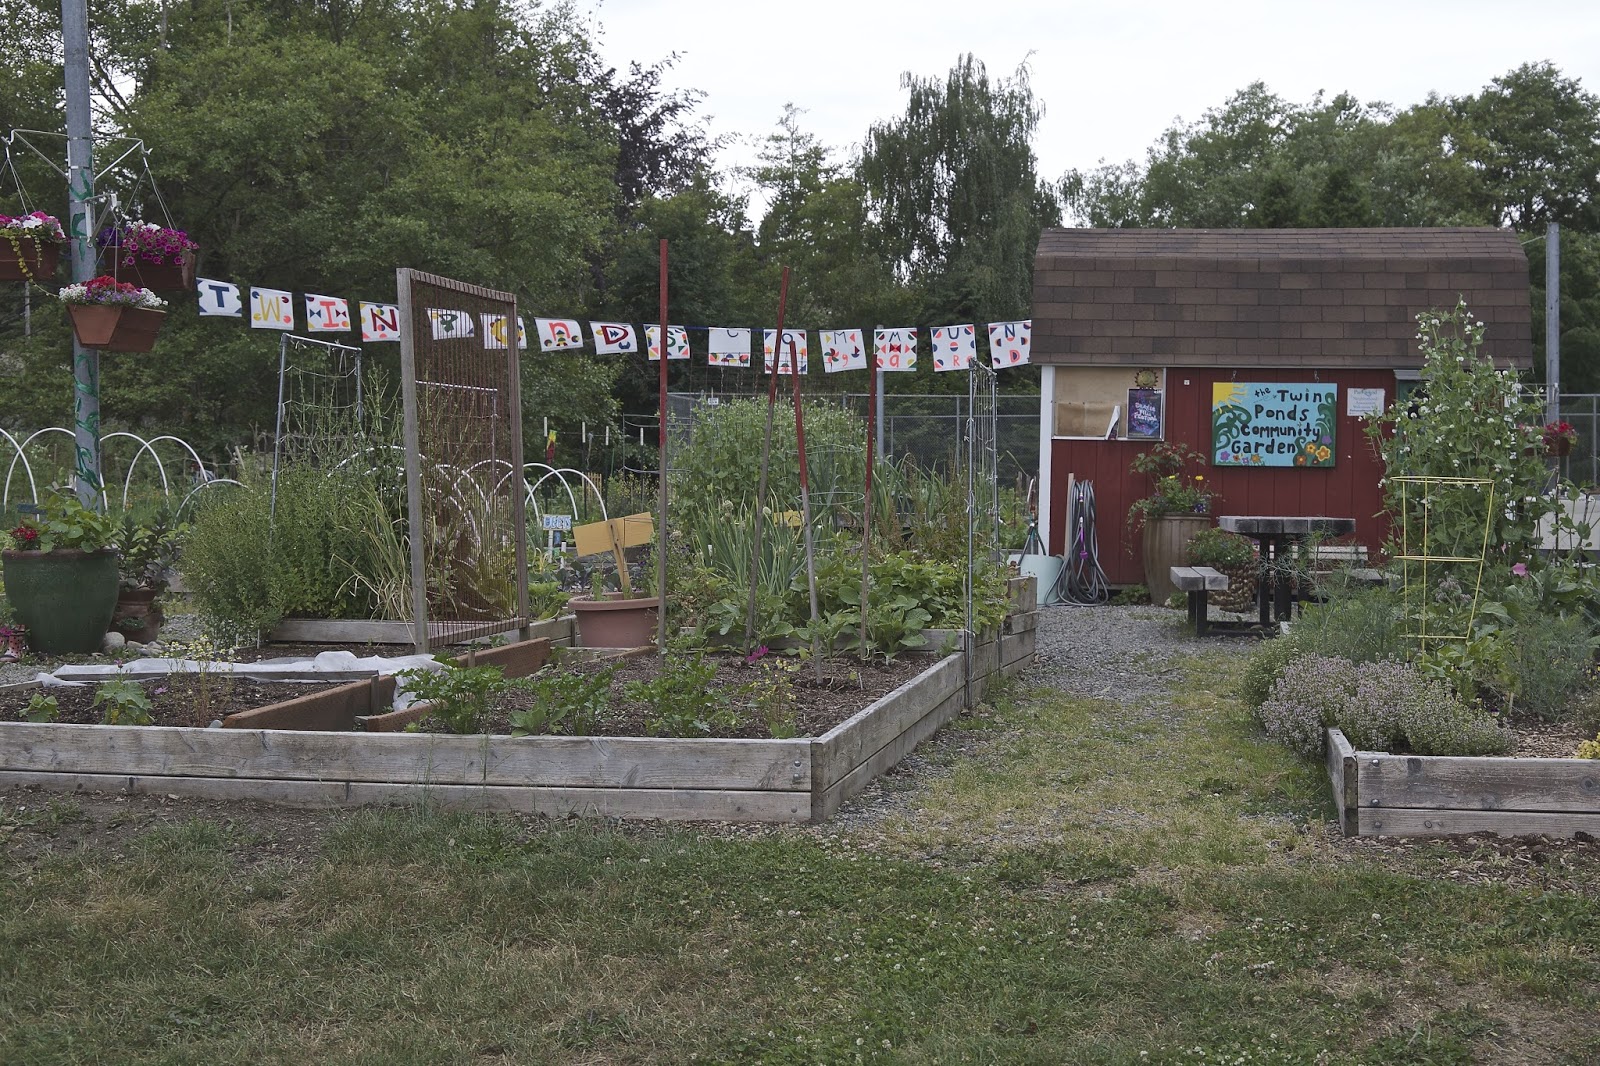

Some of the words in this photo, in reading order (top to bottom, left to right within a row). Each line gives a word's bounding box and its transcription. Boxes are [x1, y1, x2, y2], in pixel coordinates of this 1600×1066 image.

[1254, 387, 1271, 398] the
[1277, 388, 1322, 403] Twin
[1254, 404, 1310, 422] Ponds
[1240, 422, 1321, 444] Community
[1231, 438, 1296, 455] Garden
